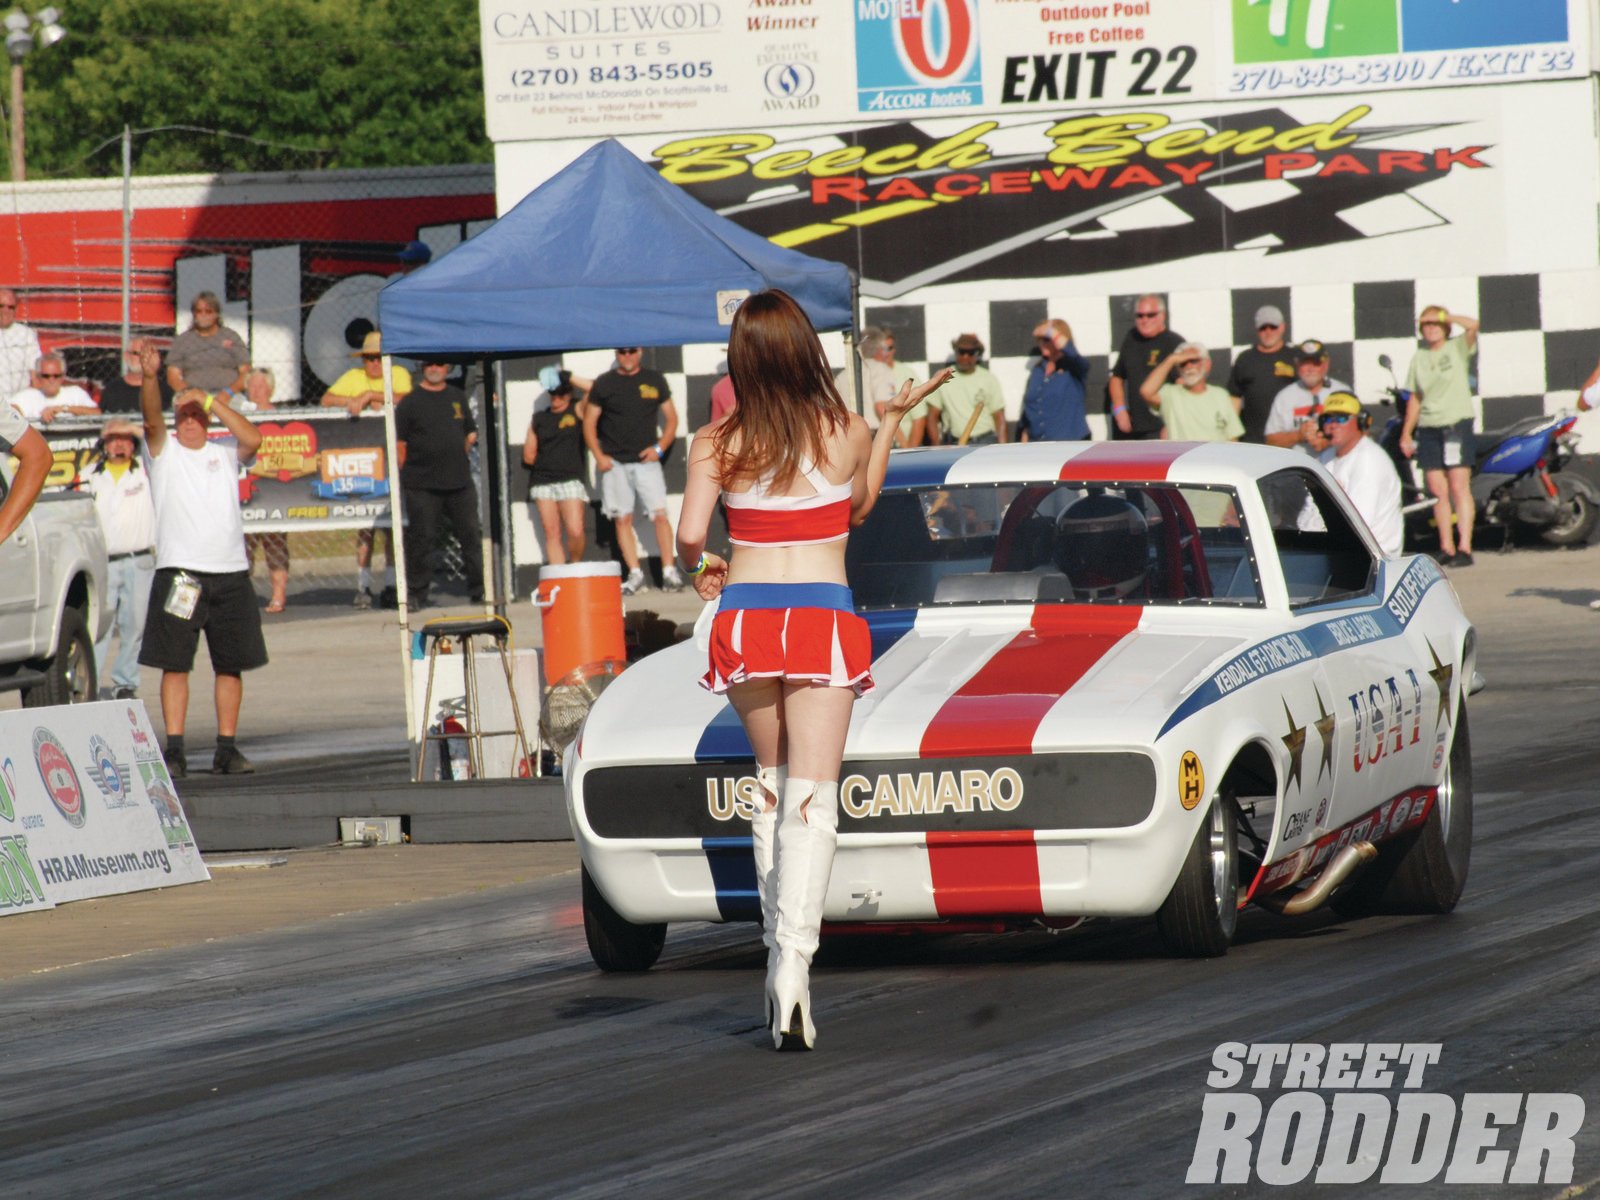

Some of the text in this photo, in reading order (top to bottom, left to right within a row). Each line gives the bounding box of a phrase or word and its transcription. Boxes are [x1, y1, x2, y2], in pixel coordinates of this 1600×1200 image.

[494, 3, 721, 38] CANDLEWOOD
[746, 15, 819, 32] Winner
[858, 0, 922, 21] MOTEL
[1041, 1, 1150, 22] Outdoor Pool
[1049, 27, 1144, 45] Free Coffee
[546, 41, 672, 60] SUITES
[511, 61, 713, 87] (270) 843-5505
[1001, 45, 1197, 104] EXIT 22
[1449, 52, 1536, 78] EXIT
[1539, 50, 1575, 71] 22
[549, 91, 582, 101] Behind
[646, 88, 658, 97] On
[761, 94, 820, 112] AWARD
[929, 88, 973, 107] hotels
[652, 104, 1372, 184] Beech Bend
[811, 144, 1494, 204] RACEWAY PARK
[327, 451, 377, 477] NOS
[242, 508, 267, 520] OR
[270, 509, 282, 519] A
[287, 506, 328, 518] FREE
[1213, 656, 1259, 695] KENDALL
[1348, 668, 1421, 773] USA-1
[841, 767, 1023, 819] CAMARO
[38, 848, 172, 885] HRAMuseum.org
